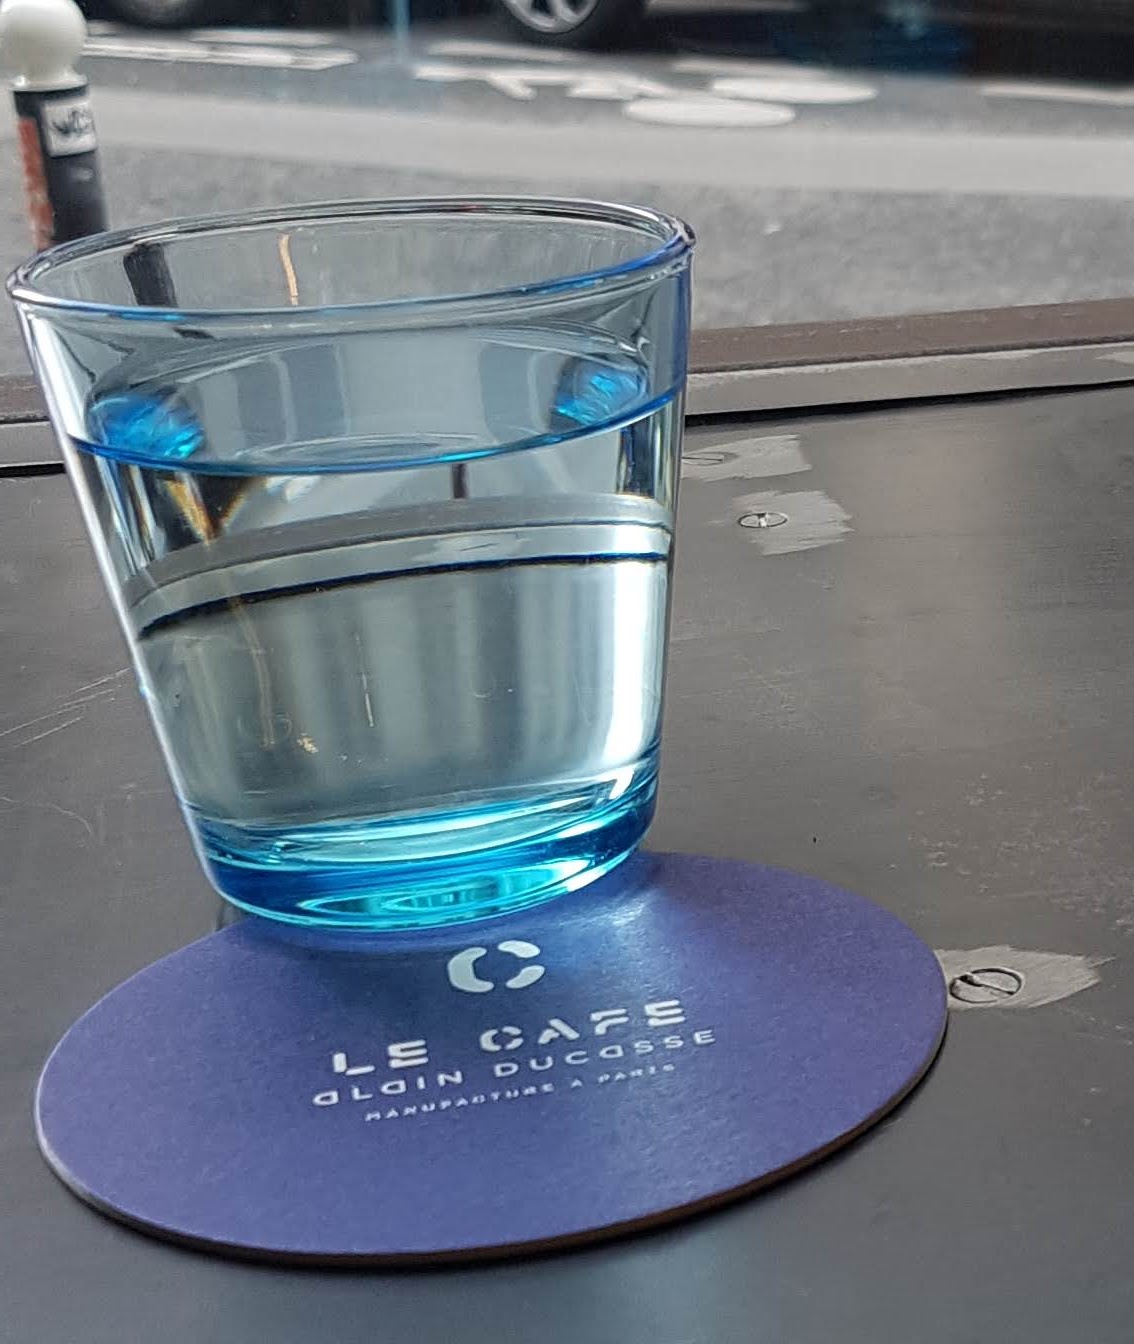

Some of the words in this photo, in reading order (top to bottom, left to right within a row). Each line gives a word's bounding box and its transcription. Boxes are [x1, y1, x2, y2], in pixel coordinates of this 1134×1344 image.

[332, 1039, 429, 1076] LE
[479, 999, 686, 1052] CAFE
[364, 1082, 555, 1122] MANUFACTURE
[597, 1063, 676, 1084] PARIS
